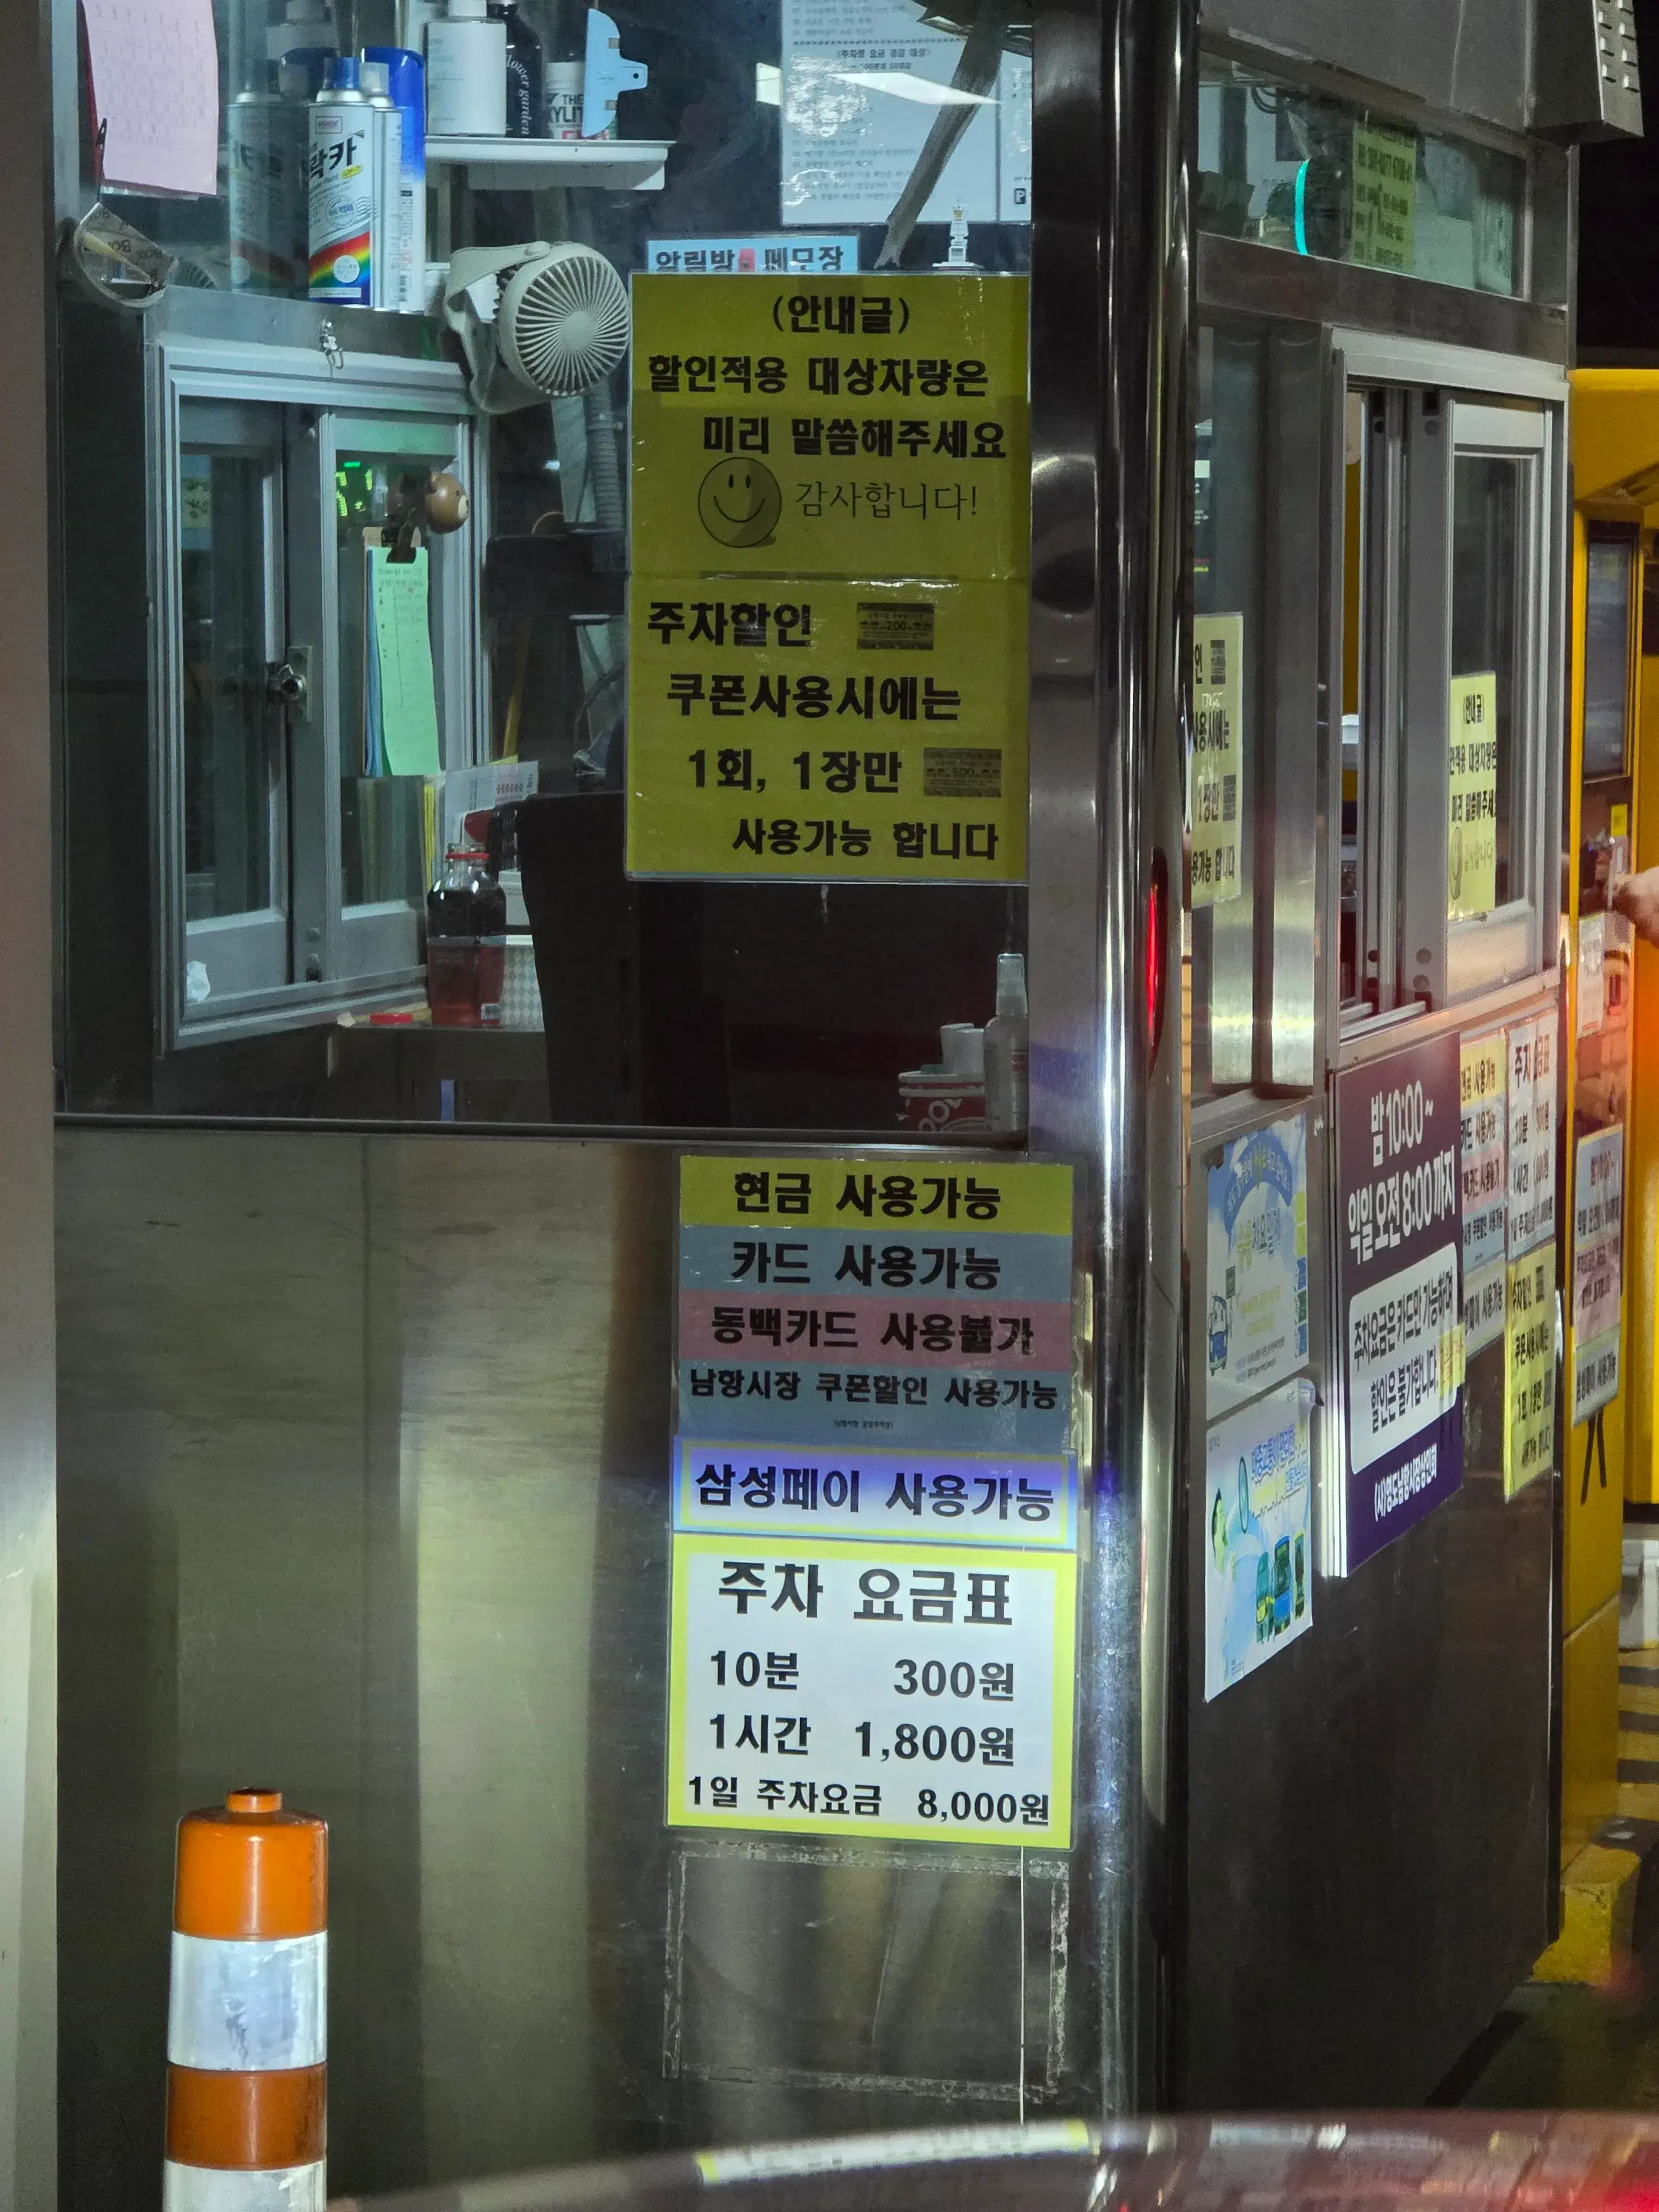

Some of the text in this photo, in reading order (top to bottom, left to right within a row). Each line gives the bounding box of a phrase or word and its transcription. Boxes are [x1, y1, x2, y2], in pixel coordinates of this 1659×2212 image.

[765, 246, 844, 273] 메모장
[772, 295, 909, 334] (안내글)
[648, 355, 988, 397] 할인적용 대상차량은
[703, 417, 1006, 459] 미리 말씀해주세요
[796, 482, 978, 520] 감사합니다!
[648, 602, 811, 646] 주차할인
[667, 673, 962, 721] 쿠폰사용시에는
[688, 748, 901, 794] 1회, 1장만
[732, 819, 999, 860] 사용가능 합니다
[1371, 1079, 1434, 1167] 밤 10:00~
[734, 1171, 1001, 1219] 현금 사용가능
[1348, 1184, 1373, 1266] 익일
[1375, 1171, 1401, 1251] 오전
[731, 1241, 1001, 1290] 카드 사용가능
[711, 1306, 1034, 1356] 동백카드 사용불가
[1354, 1300, 1396, 1370] 주차요금은
[690, 1368, 1058, 1409] 남항시장 쿠폰할인 사용가능
[1370, 1368, 1396, 1434] 할인은
[695, 1463, 1055, 1522] 삼성페이 사용가능
[718, 1560, 1013, 1625] 주차 요금표
[710, 1650, 1014, 1702] 10분 300원
[710, 1713, 1014, 1767] 1시간 1,800원
[688, 1775, 1050, 1827] 1일 주차요금 8,000원
